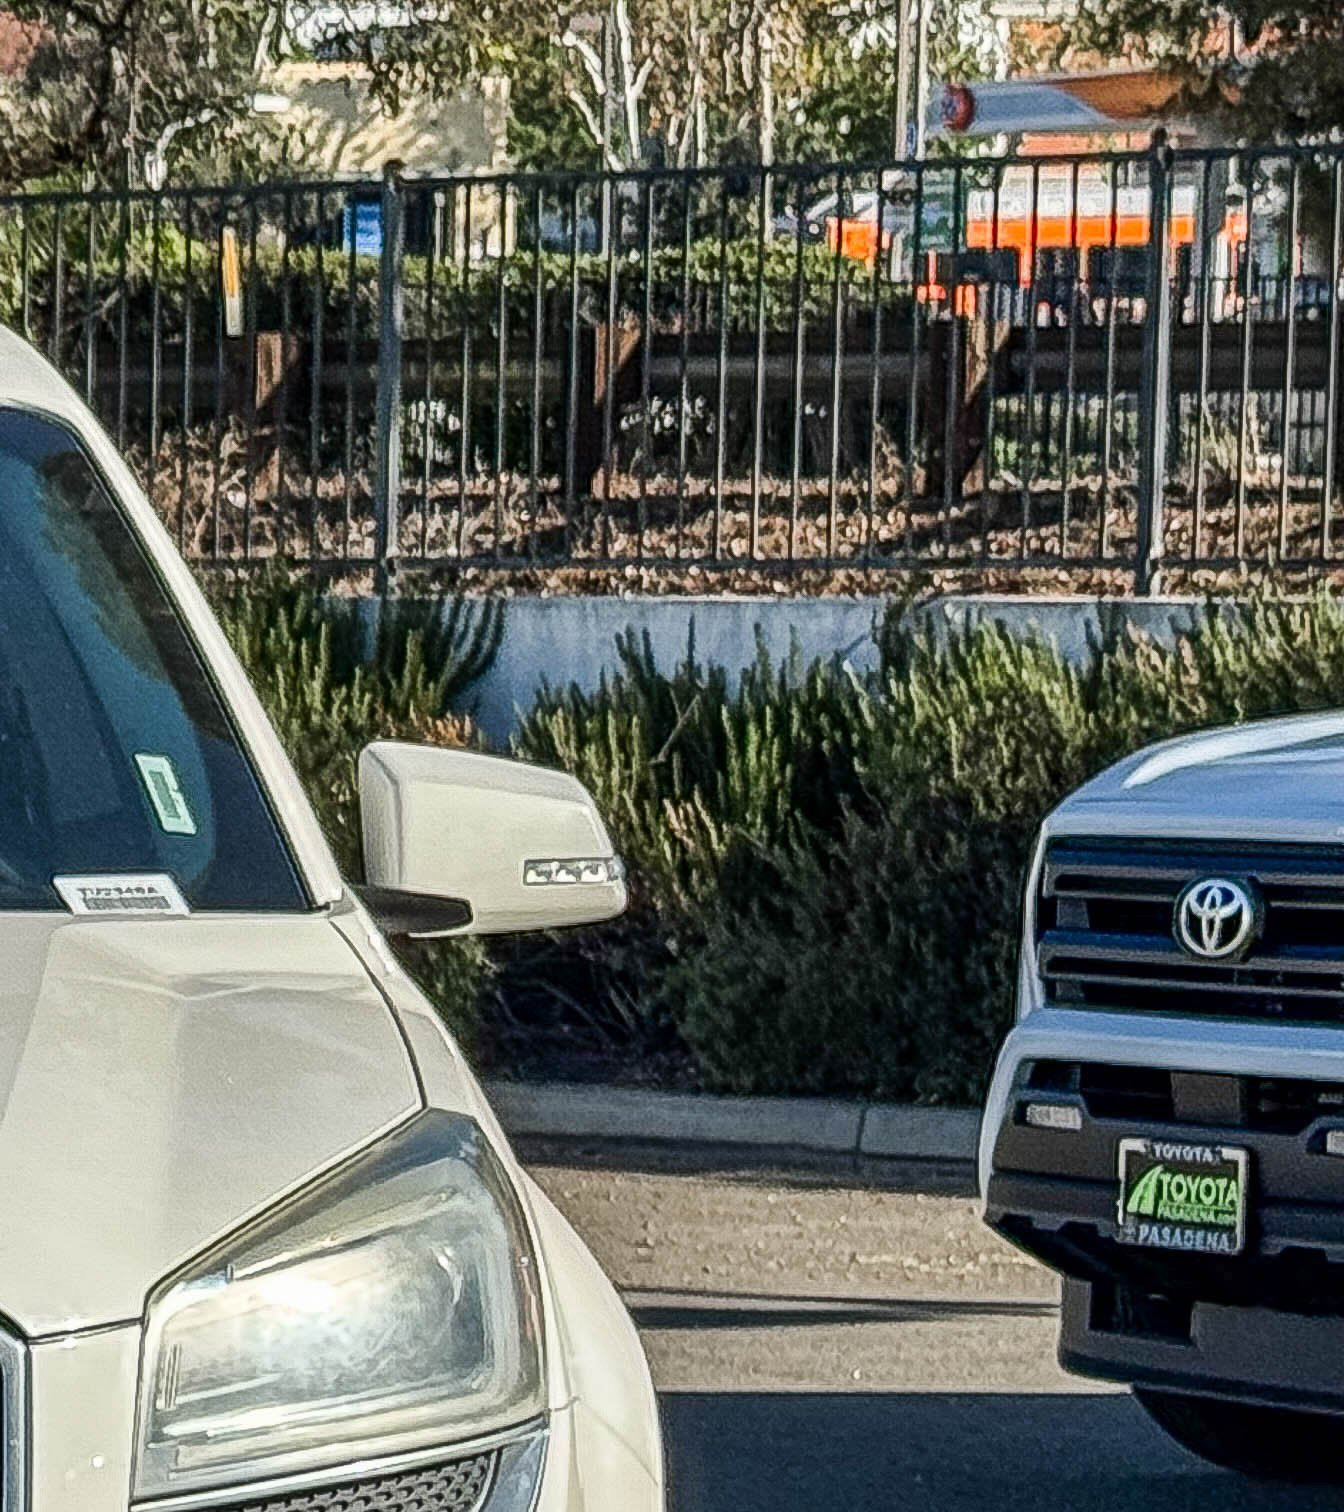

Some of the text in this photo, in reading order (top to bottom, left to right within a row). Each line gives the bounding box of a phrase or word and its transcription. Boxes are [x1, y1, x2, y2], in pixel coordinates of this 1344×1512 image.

[1153, 1142, 1215, 1163] TOYOTA
[1160, 1172, 1239, 1208] TOYOTA
[1137, 1223, 1231, 1251] PASADENA
